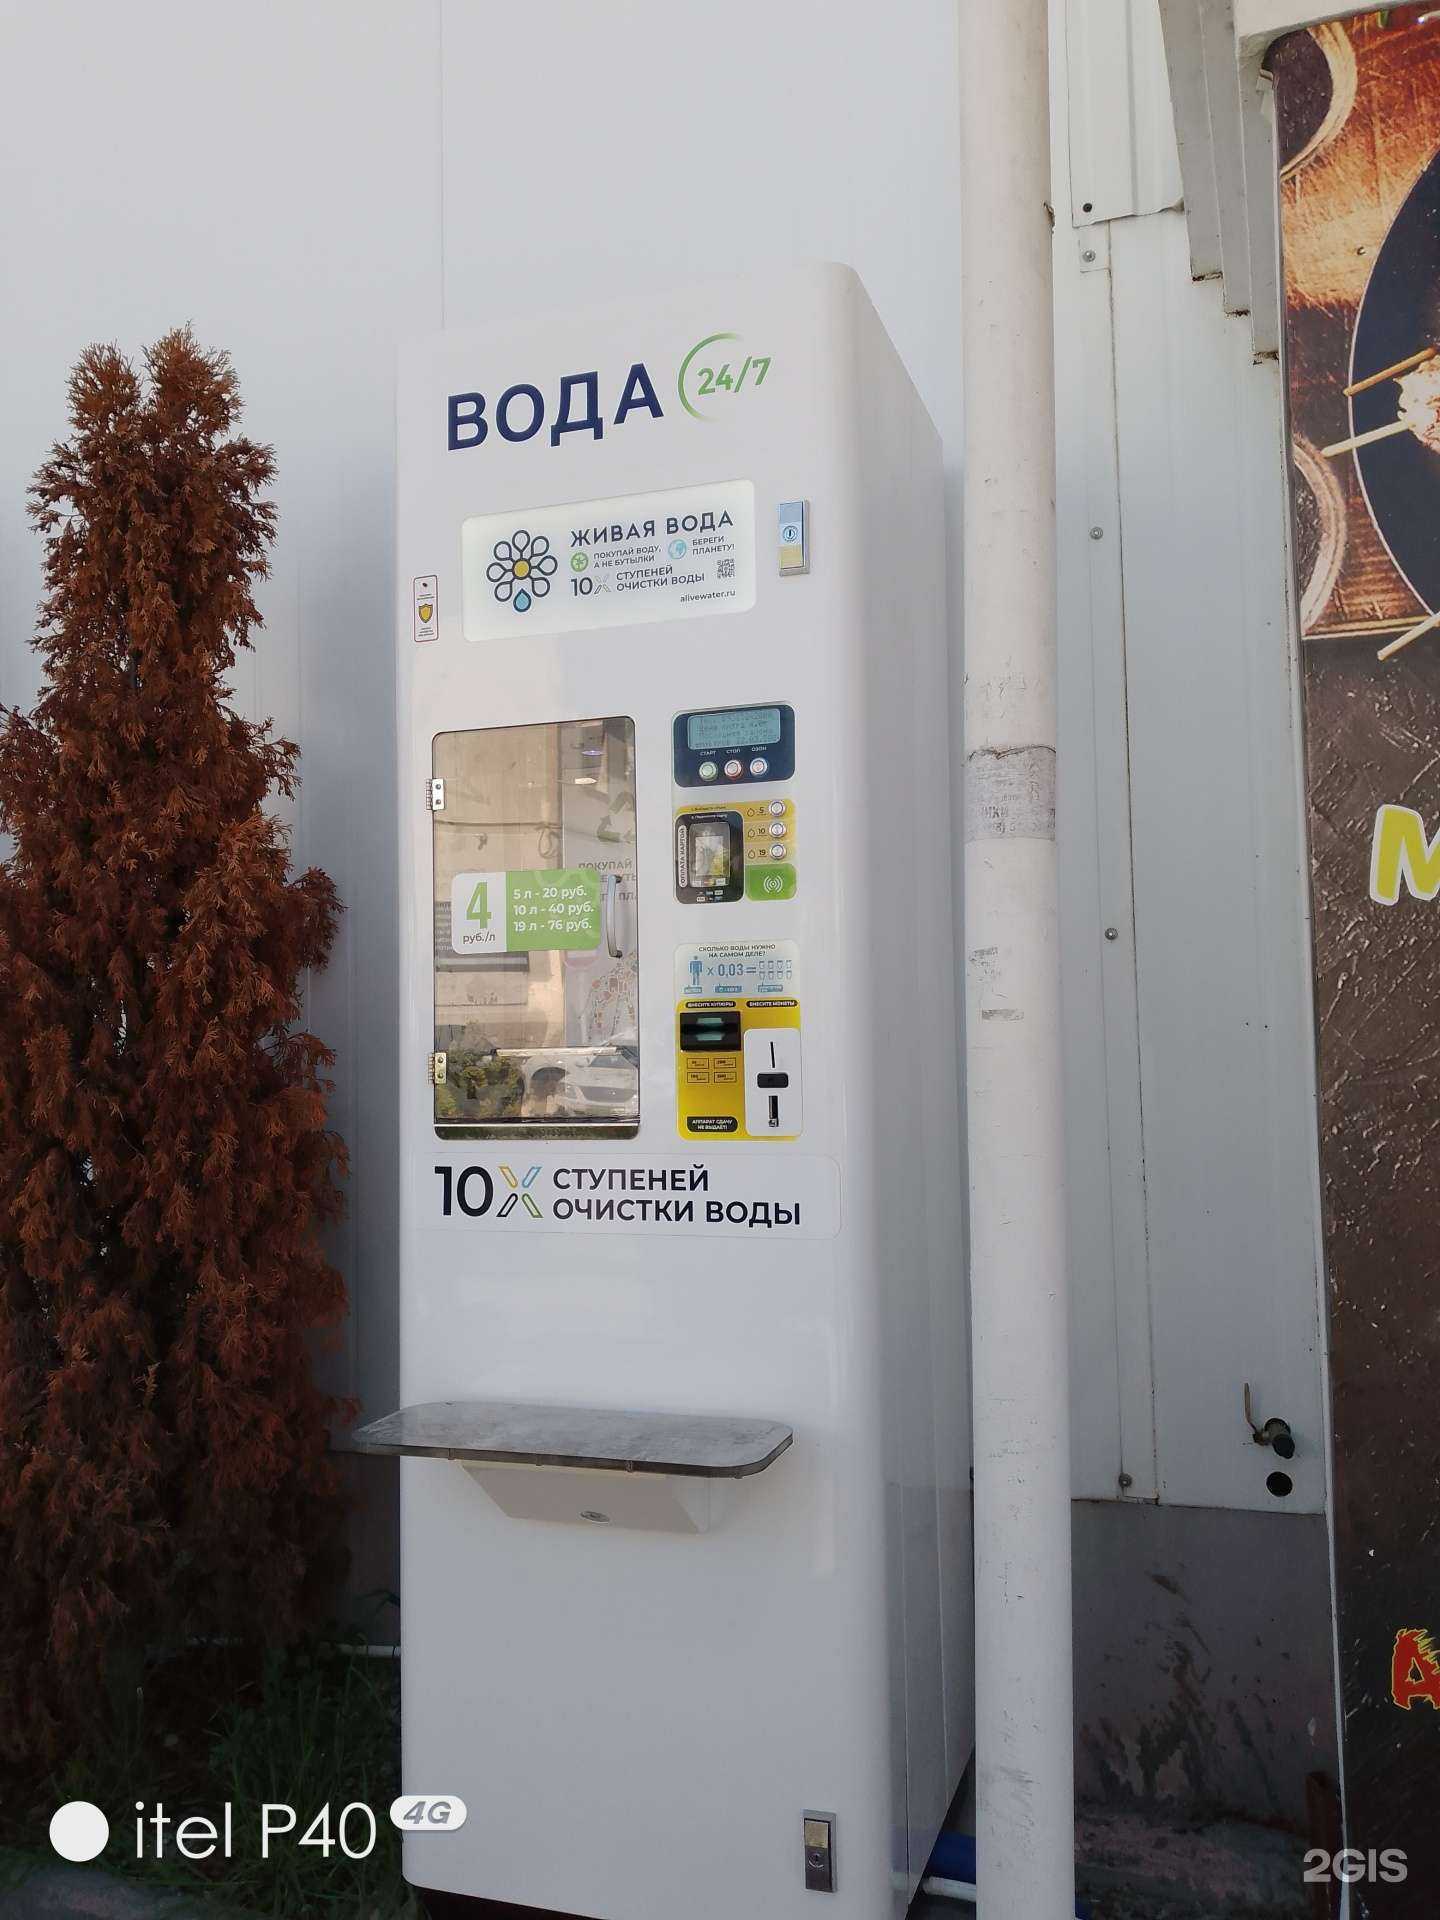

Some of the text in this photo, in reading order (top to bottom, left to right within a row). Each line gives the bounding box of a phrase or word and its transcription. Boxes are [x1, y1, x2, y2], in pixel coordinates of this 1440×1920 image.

[448, 356, 772, 451] ВОДА 24/7
[570, 510, 733, 547] ЖИВАЯ ВОДА
[692, 535, 724, 546] БЕРЕГИ
[594, 545, 662, 560] ПОКУПАЙ ВОДУ,
[692, 544, 735, 555] ПЛАНЕТУ!
[602, 560, 613, 568] НЕ
[615, 555, 655, 566] БУТЫЛКИ
[616, 565, 673, 581] СТУПЕНЕЙ
[616, 573, 705, 592] ОЧИСТКИ ВОДЫ
[680, 590, 736, 603] alivewater.ru
[513, 889, 521, 900] 5
[524, 890, 532, 899] л
[543, 887, 557, 898] 20
[561, 885, 587, 900] руб.
[466, 881, 492, 929] 4
[513, 905, 526, 916] 10
[529, 906, 537, 915] л
[548, 903, 564, 914] 40
[568, 901, 594, 916] руб.
[513, 921, 526, 932] 19
[529, 922, 537, 931] л
[548, 920, 563, 930] 76
[566, 918, 592, 932] руб.
[463, 931, 496, 944] руб./л
[718, 963, 744, 978] 0,03
[553, 1164, 709, 1192] СТУПЕНЕЙ
[553, 1197, 801, 1228] ОЧИСТКИ ВОДЫ
